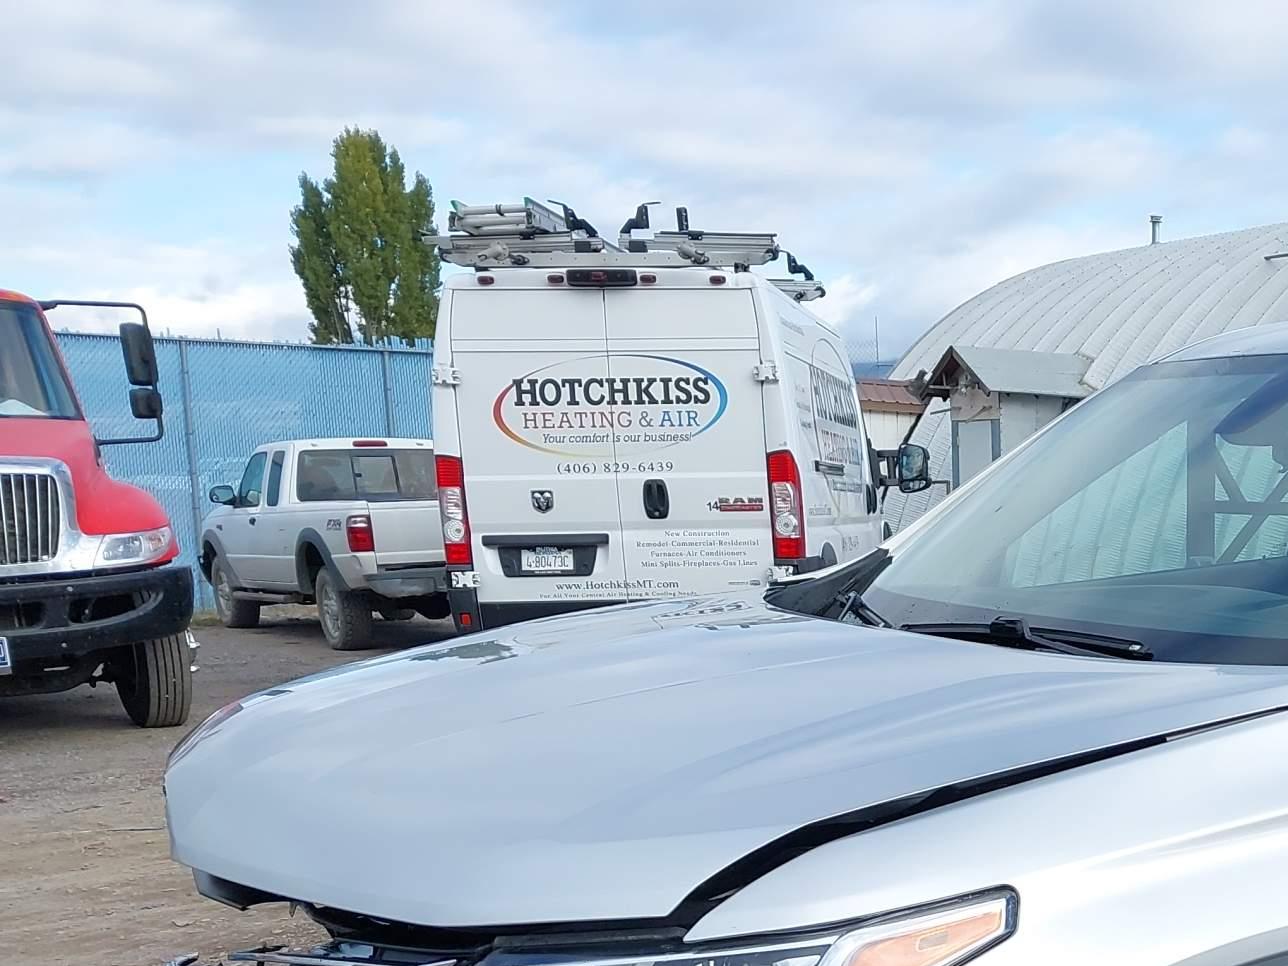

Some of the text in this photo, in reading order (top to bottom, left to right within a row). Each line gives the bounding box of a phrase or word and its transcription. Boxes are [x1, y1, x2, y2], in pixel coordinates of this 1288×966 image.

[512, 376, 711, 407] HOTCHKISS
[522, 410, 700, 429] HEATING & AIR
[542, 433, 566, 444] Your
[568, 432, 609, 444] comfort
[623, 434, 641, 443] our
[643, 432, 692, 443] business!
[557, 461, 674, 475] (406) 829-6439
[683, 529, 730, 537] Construction
[700, 549, 747, 557] Conditioners
[555, 579, 680, 590] www.HotchkissMT.com
